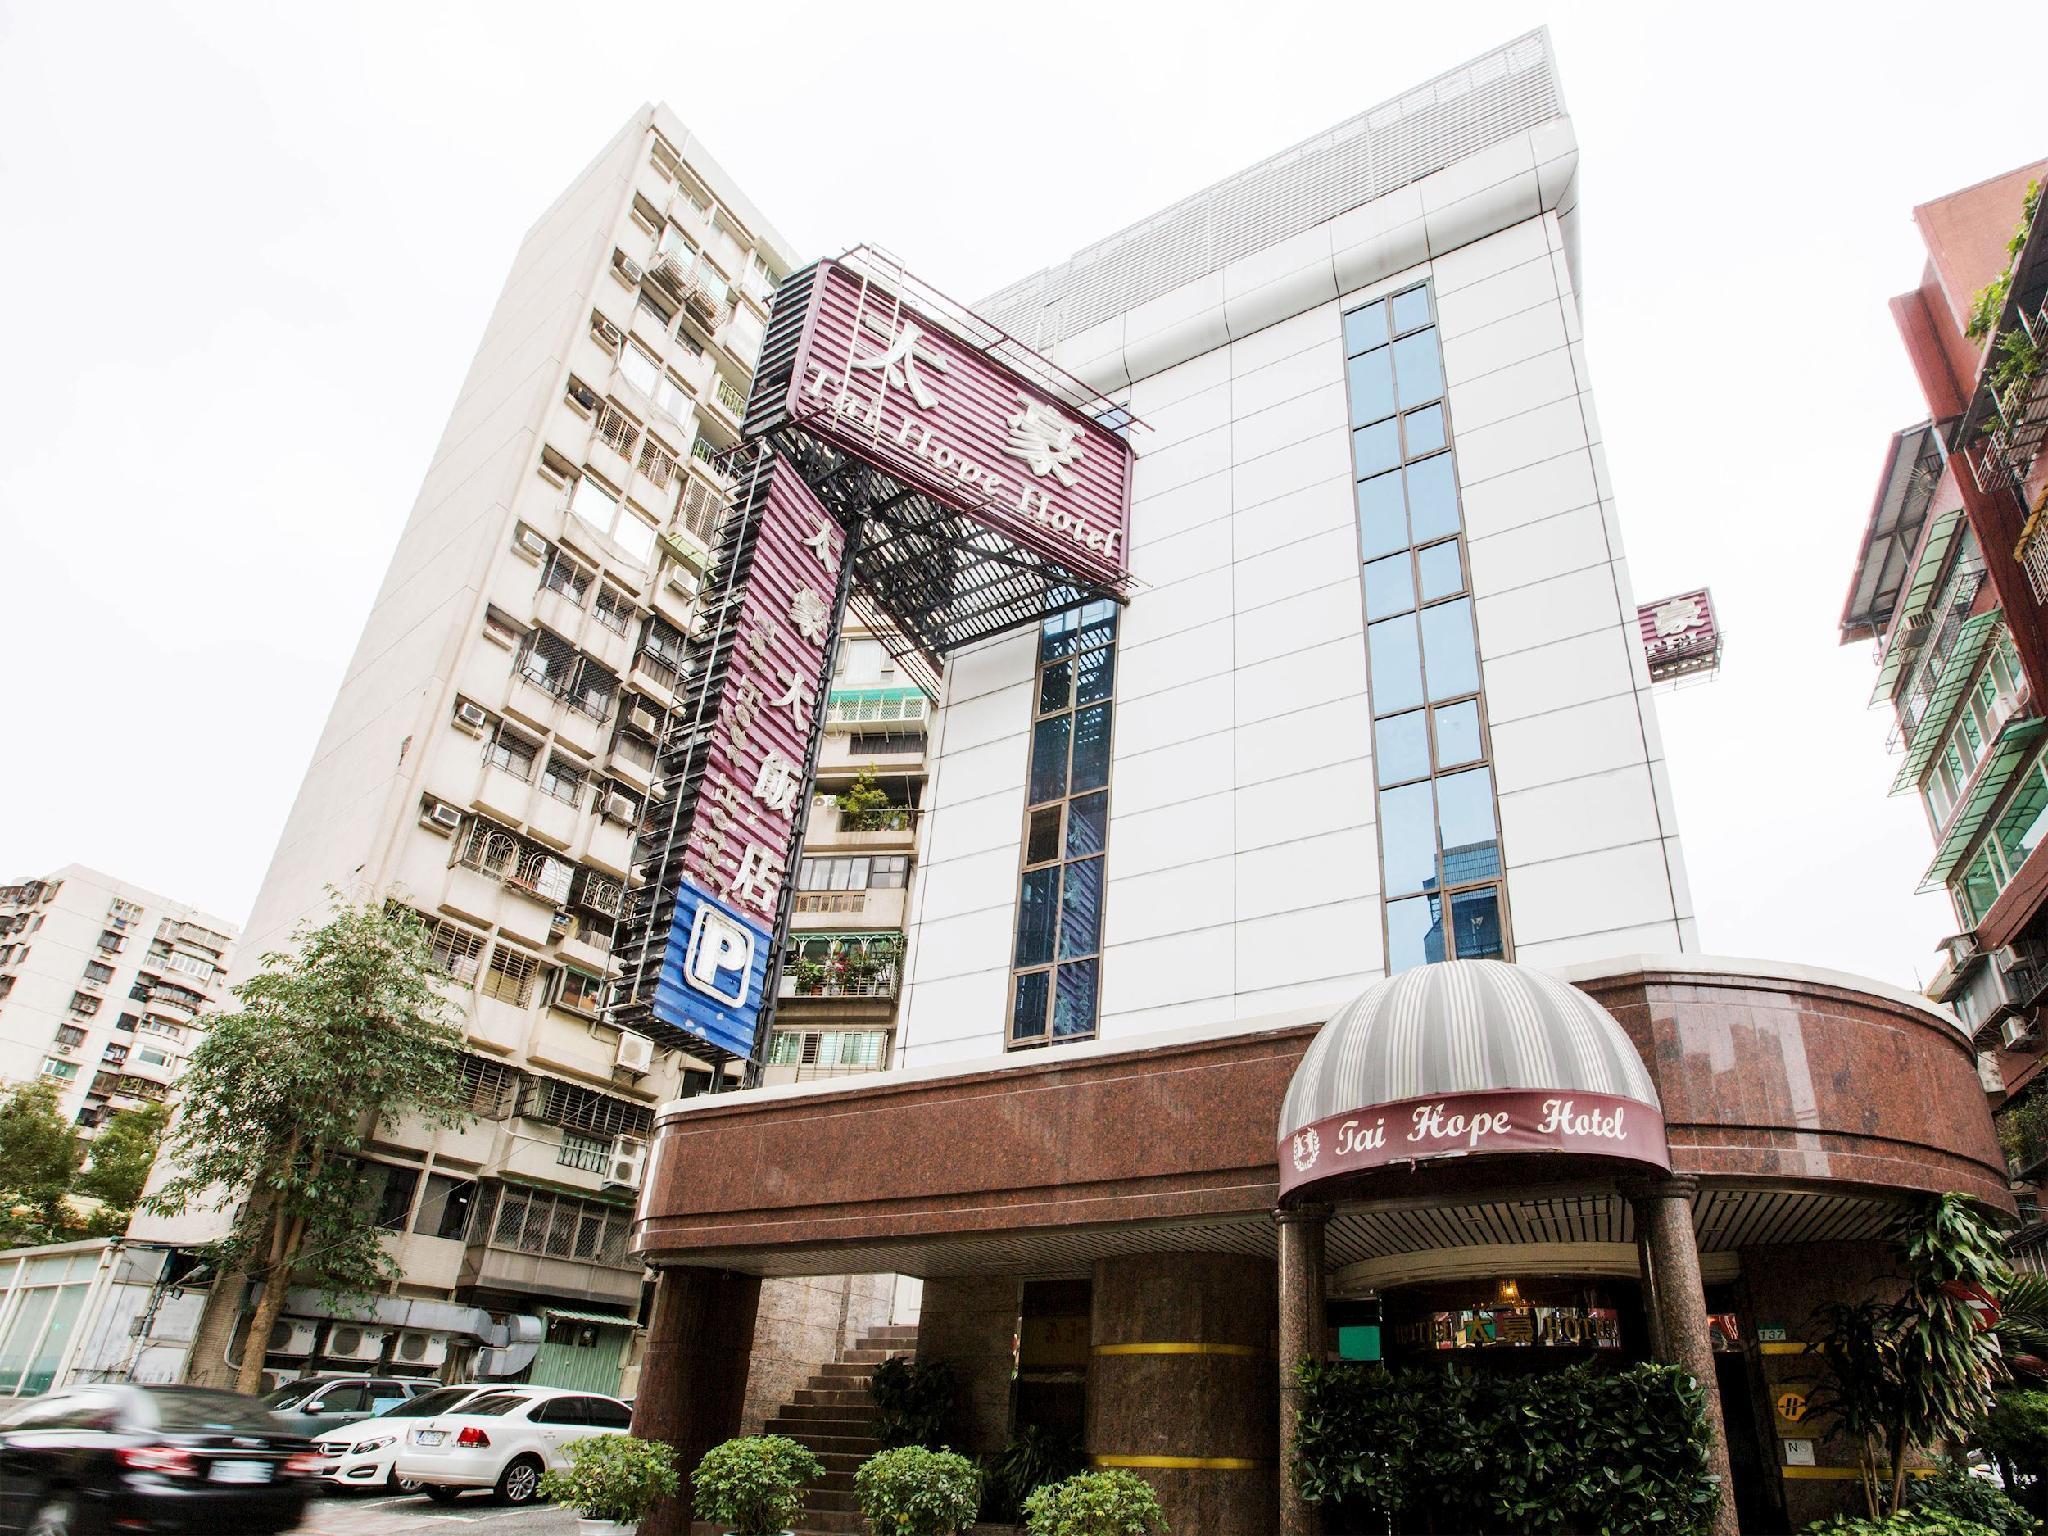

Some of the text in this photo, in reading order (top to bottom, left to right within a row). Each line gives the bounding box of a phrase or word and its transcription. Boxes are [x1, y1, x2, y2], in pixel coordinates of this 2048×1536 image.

[802, 362, 1123, 558] Tai Hope Hotel
[696, 915, 748, 985] P
[1335, 1117, 1386, 1157] Tai
[1407, 1102, 1511, 1147] Hope
[1537, 1099, 1627, 1141] Hotel
[1760, 1330, 1784, 1340] 137
